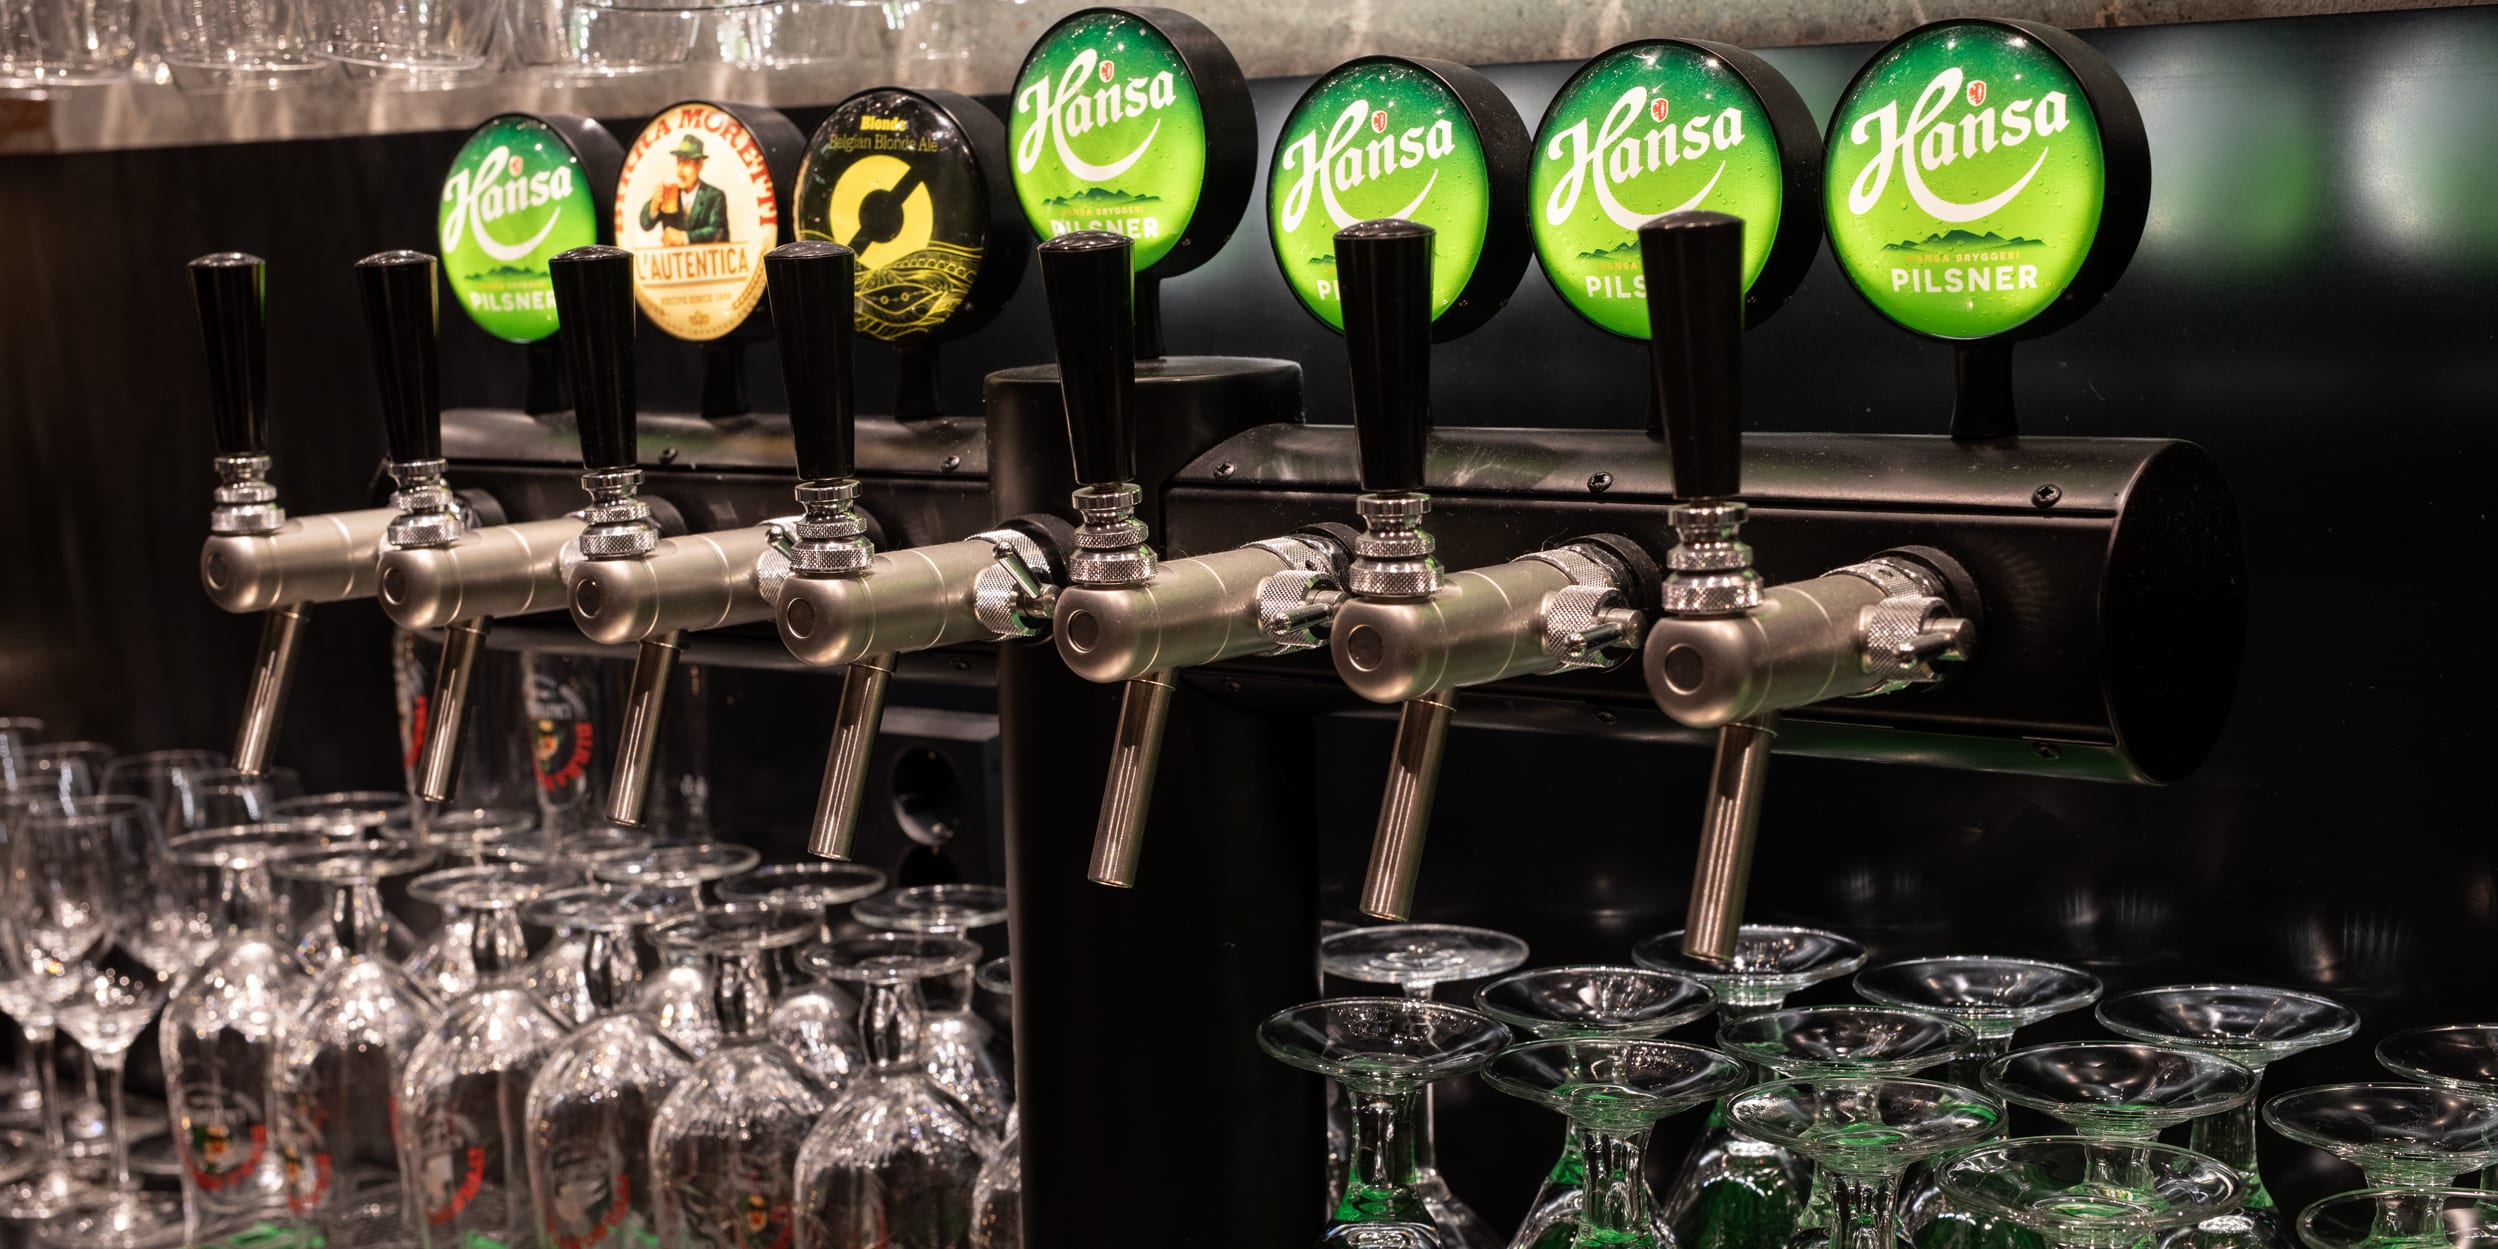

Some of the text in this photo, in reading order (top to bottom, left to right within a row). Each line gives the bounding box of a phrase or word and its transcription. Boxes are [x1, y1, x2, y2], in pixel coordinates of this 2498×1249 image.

[860, 114, 908, 131] Blonde
[1017, 48, 1176, 182] Hansa
[829, 133, 939, 153] Belgian Blonde Ale
[1545, 86, 1745, 231] Hansa
[1848, 66, 2070, 222] Hansa
[678, 109, 778, 227] MORETTI
[1281, 100, 1455, 233] Hansa
[441, 145, 573, 261] Hansa
[635, 247, 750, 281] L'AUTENTICA
[1956, 251, 2020, 262] BRYGGERI
[1585, 275, 1647, 298] PILS
[1890, 264, 2038, 293] PILSNER
[470, 290, 557, 312] PILSNER
